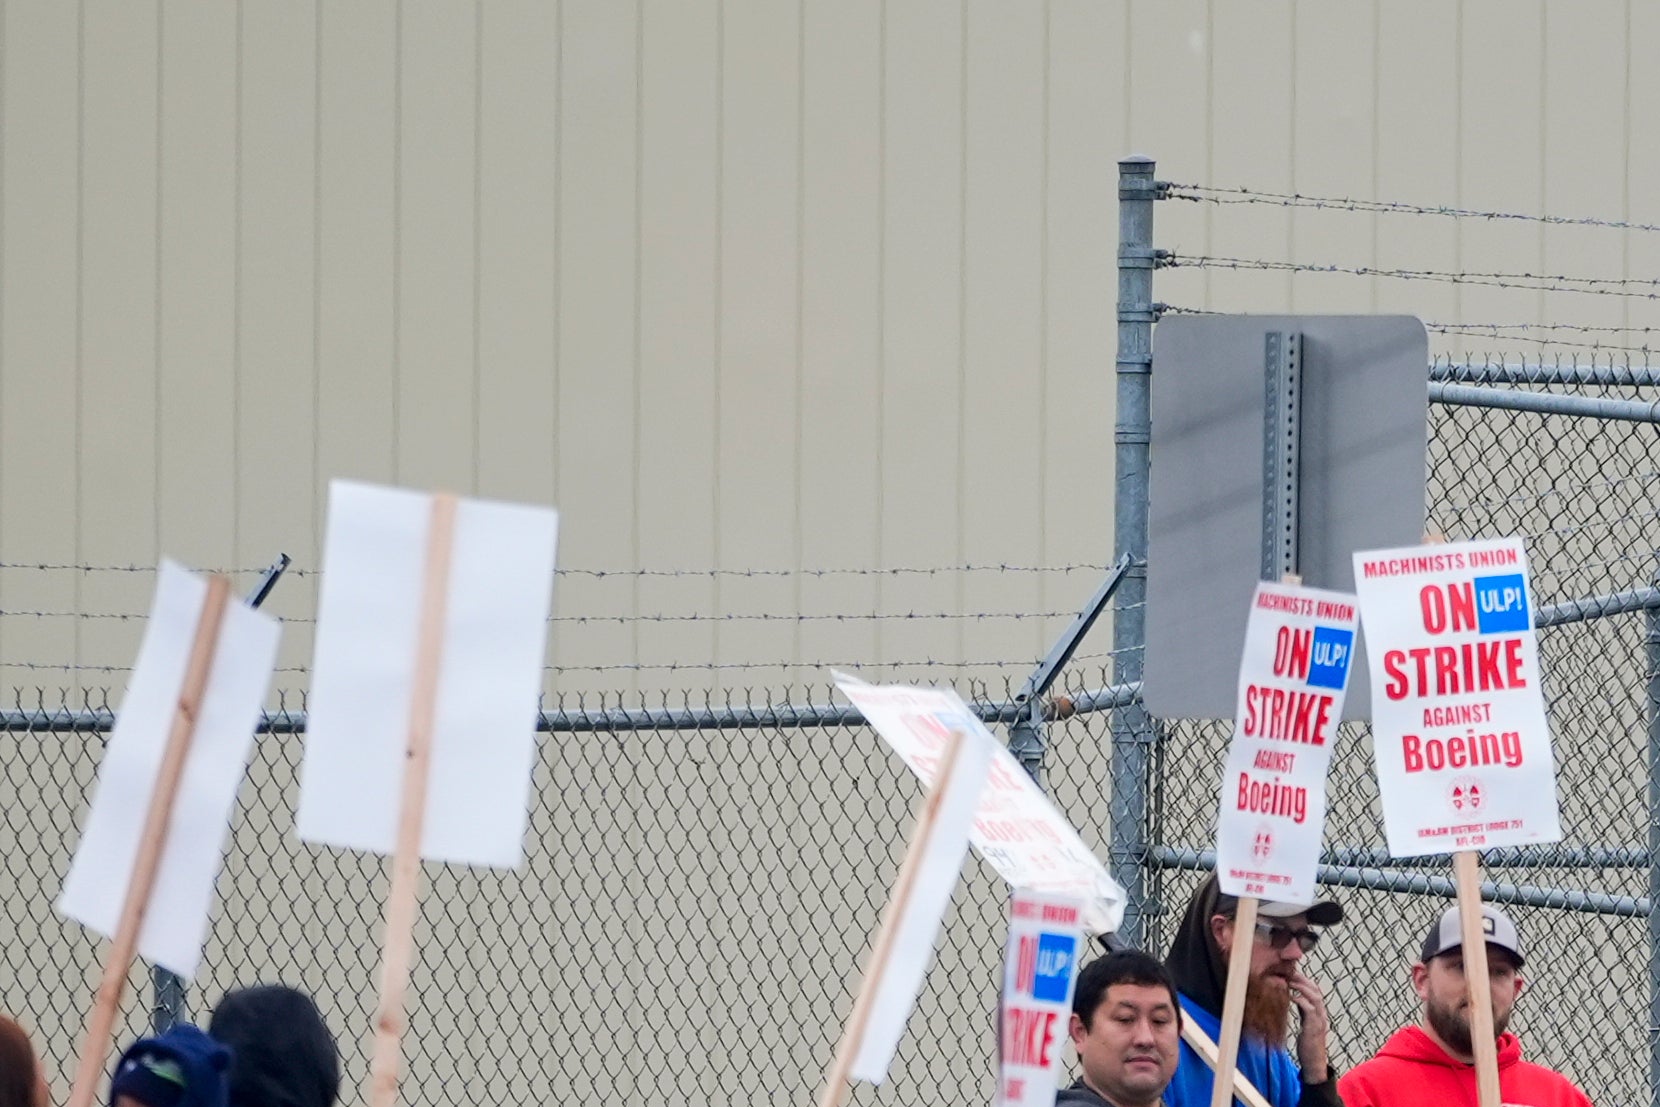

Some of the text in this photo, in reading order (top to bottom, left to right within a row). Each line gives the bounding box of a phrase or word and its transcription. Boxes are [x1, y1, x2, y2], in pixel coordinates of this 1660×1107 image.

[1363, 549, 1517, 578] MACHINISTS UNION
[1257, 592, 1355, 622] MACHINISTS UNION
[1420, 581, 1523, 635] ON ULP!
[1274, 625, 1348, 680] ON ULP!
[1384, 638, 1527, 701] STRIKE
[1244, 684, 1334, 745] STRIKE
[1423, 703, 1491, 728] AGAINST
[1254, 750, 1296, 774] AGAINST
[1402, 729, 1523, 774] Boeing
[1237, 772, 1308, 824] Boeing
